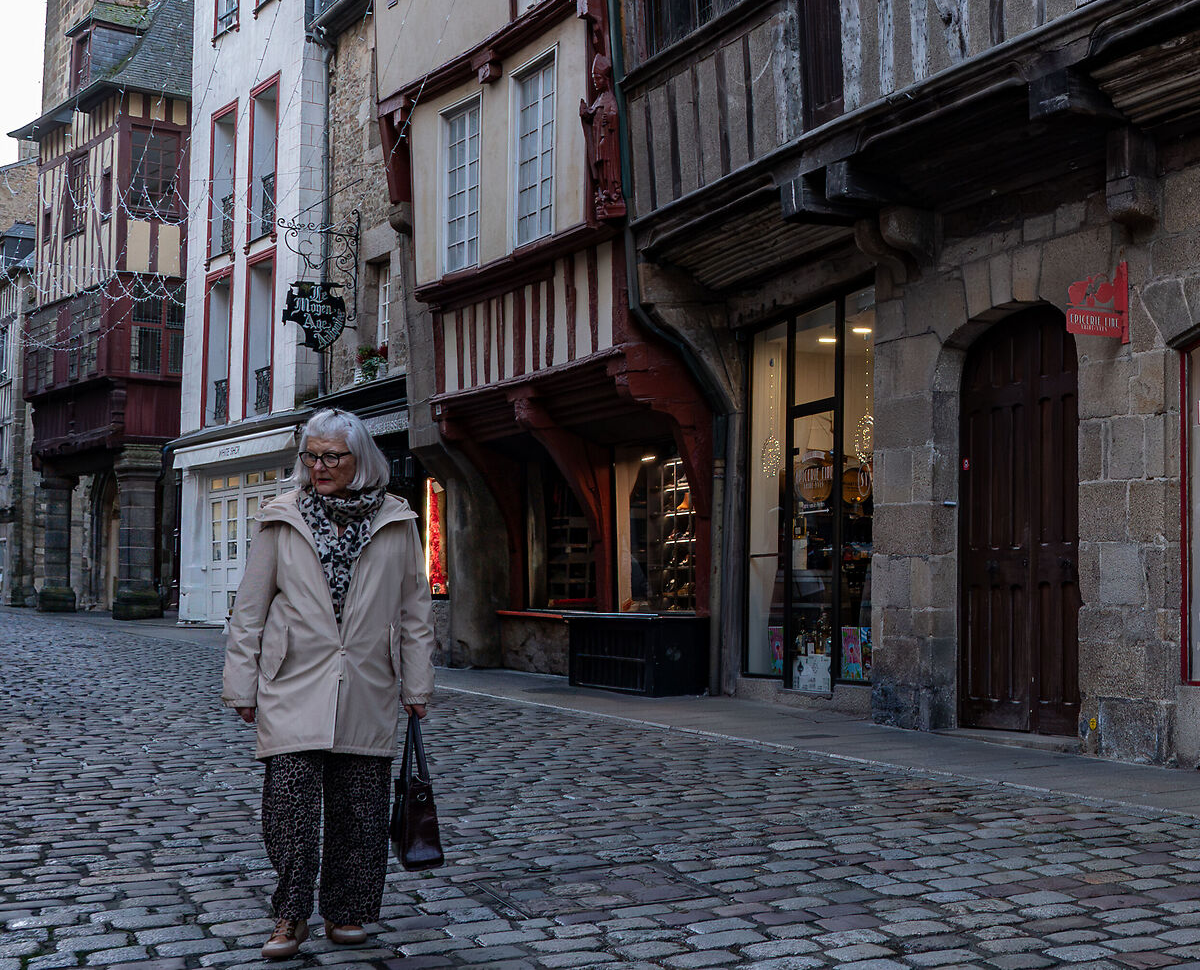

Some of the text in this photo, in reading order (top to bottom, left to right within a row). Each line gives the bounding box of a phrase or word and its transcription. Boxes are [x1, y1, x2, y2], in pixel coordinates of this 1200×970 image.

[310, 285, 328, 303] Le
[291, 297, 334, 316] Moyen
[1070, 313, 1119, 329] EPICERIE FINE
